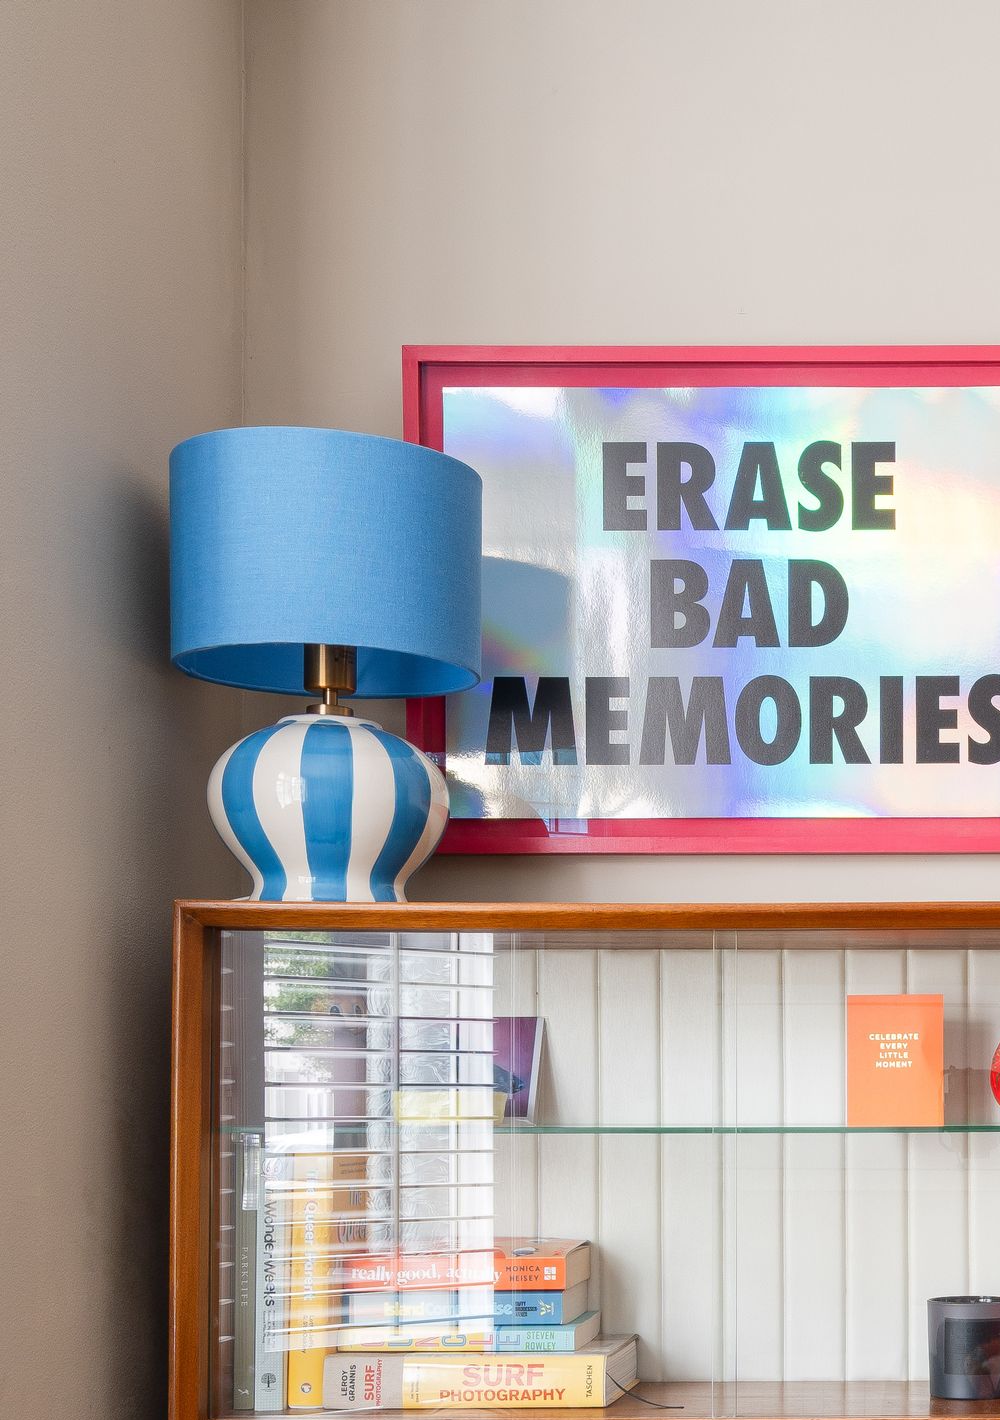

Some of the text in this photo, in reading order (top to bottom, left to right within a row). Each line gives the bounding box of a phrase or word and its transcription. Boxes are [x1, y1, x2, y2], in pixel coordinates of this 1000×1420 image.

[602, 440, 896, 532] ERASE
[649, 558, 850, 649] BAD
[868, 1032, 920, 1041] CELEBRATE
[879, 1042, 909, 1050] EVERY
[875, 1060, 913, 1068] MOMENT
[879, 1051, 909, 1059] LITTLE
[304, 1201, 319, 1247] Queer
[240, 1246, 249, 1308] PARKLIFE
[264, 1260, 277, 1308] Weeks
[351, 1263, 393, 1284] really
[396, 1263, 441, 1287] good,
[509, 1274, 540, 1282] HEISEY
[525, 1341, 557, 1350] ROWLEY
[526, 1331, 555, 1340] STEVEN
[341, 1369, 349, 1397] LEROY
[349, 1364, 357, 1402] GRANNIS
[364, 1364, 375, 1401] SURF
[375, 1358, 383, 1407] PHOTOGRAPHY
[462, 1363, 545, 1387] SURF
[586, 1364, 594, 1398] TASCHEN
[439, 1388, 566, 1402] PHOTOGRAPHY
